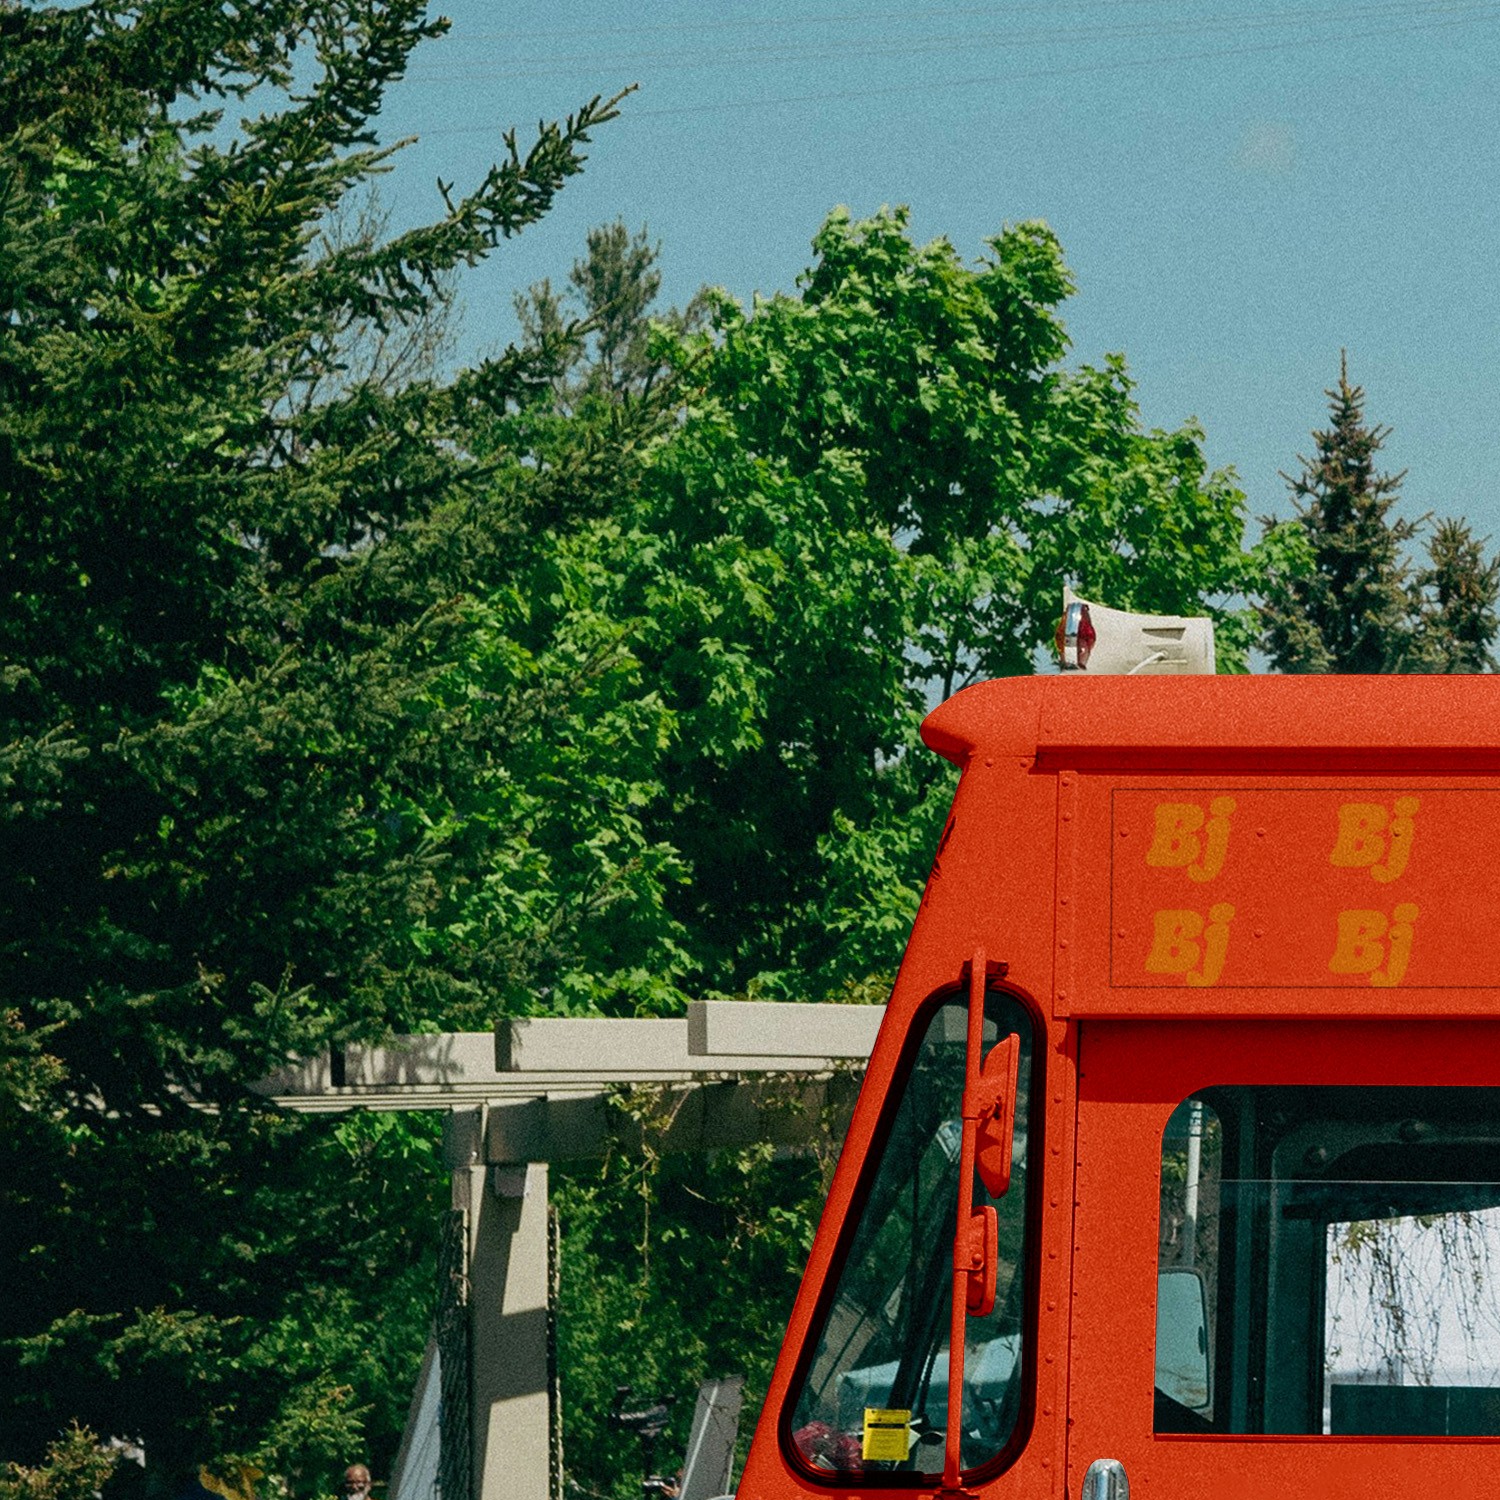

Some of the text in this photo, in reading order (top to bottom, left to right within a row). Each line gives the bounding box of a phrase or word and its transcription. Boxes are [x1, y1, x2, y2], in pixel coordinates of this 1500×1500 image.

[1146, 796, 1236, 882] Bj
[1329, 796, 1420, 882] Bj
[1145, 903, 1235, 987] Bj
[1328, 903, 1419, 987] Bj
